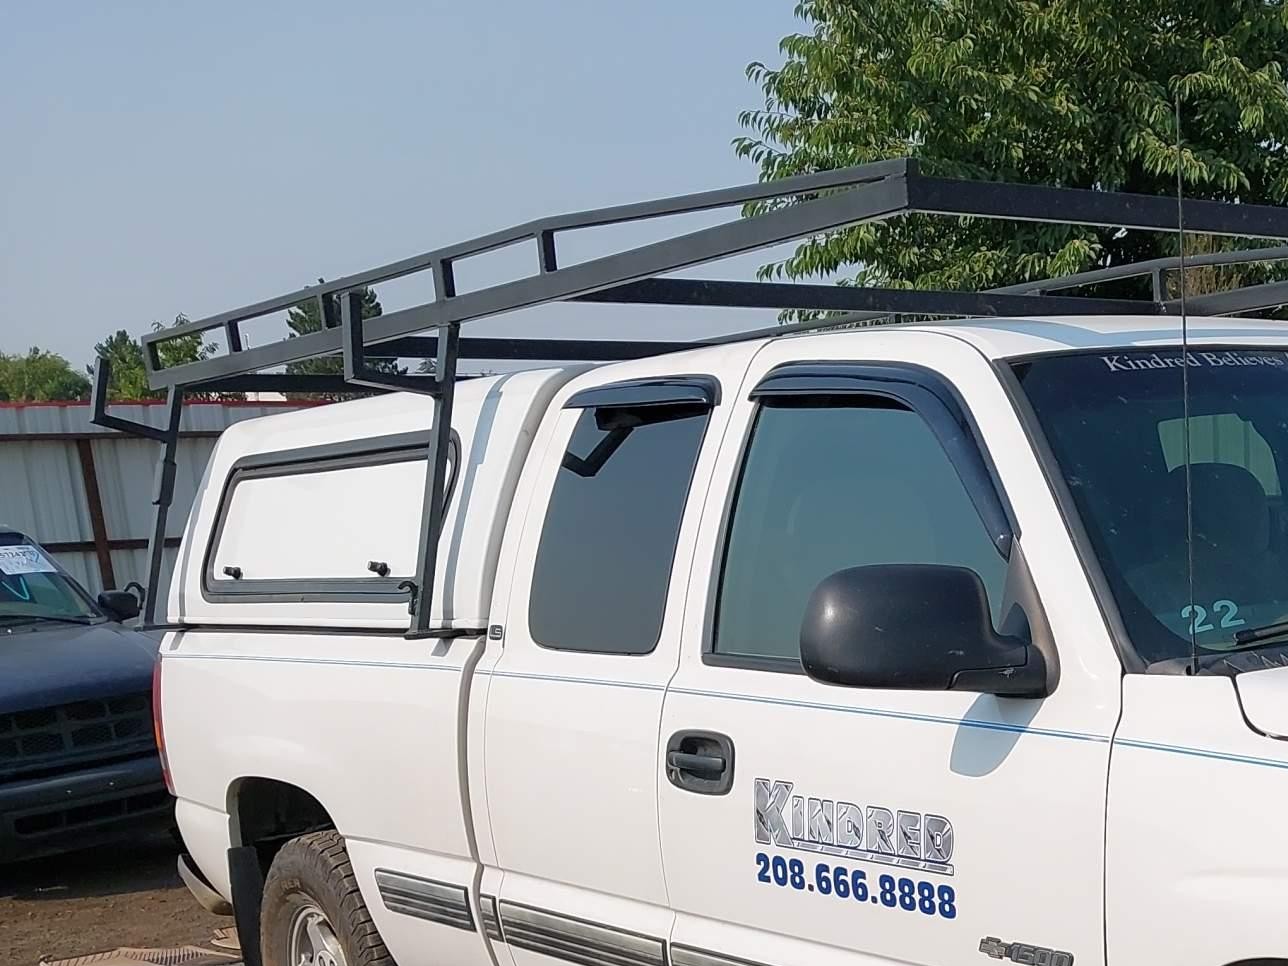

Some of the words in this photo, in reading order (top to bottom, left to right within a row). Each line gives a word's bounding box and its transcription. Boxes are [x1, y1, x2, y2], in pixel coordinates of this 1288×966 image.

[1102, 352, 1202, 371] Kindred
[1199, 352, 1284, 367] Believes
[1180, 599, 1245, 635] 22
[756, 853, 957, 919] 208.666.8888
